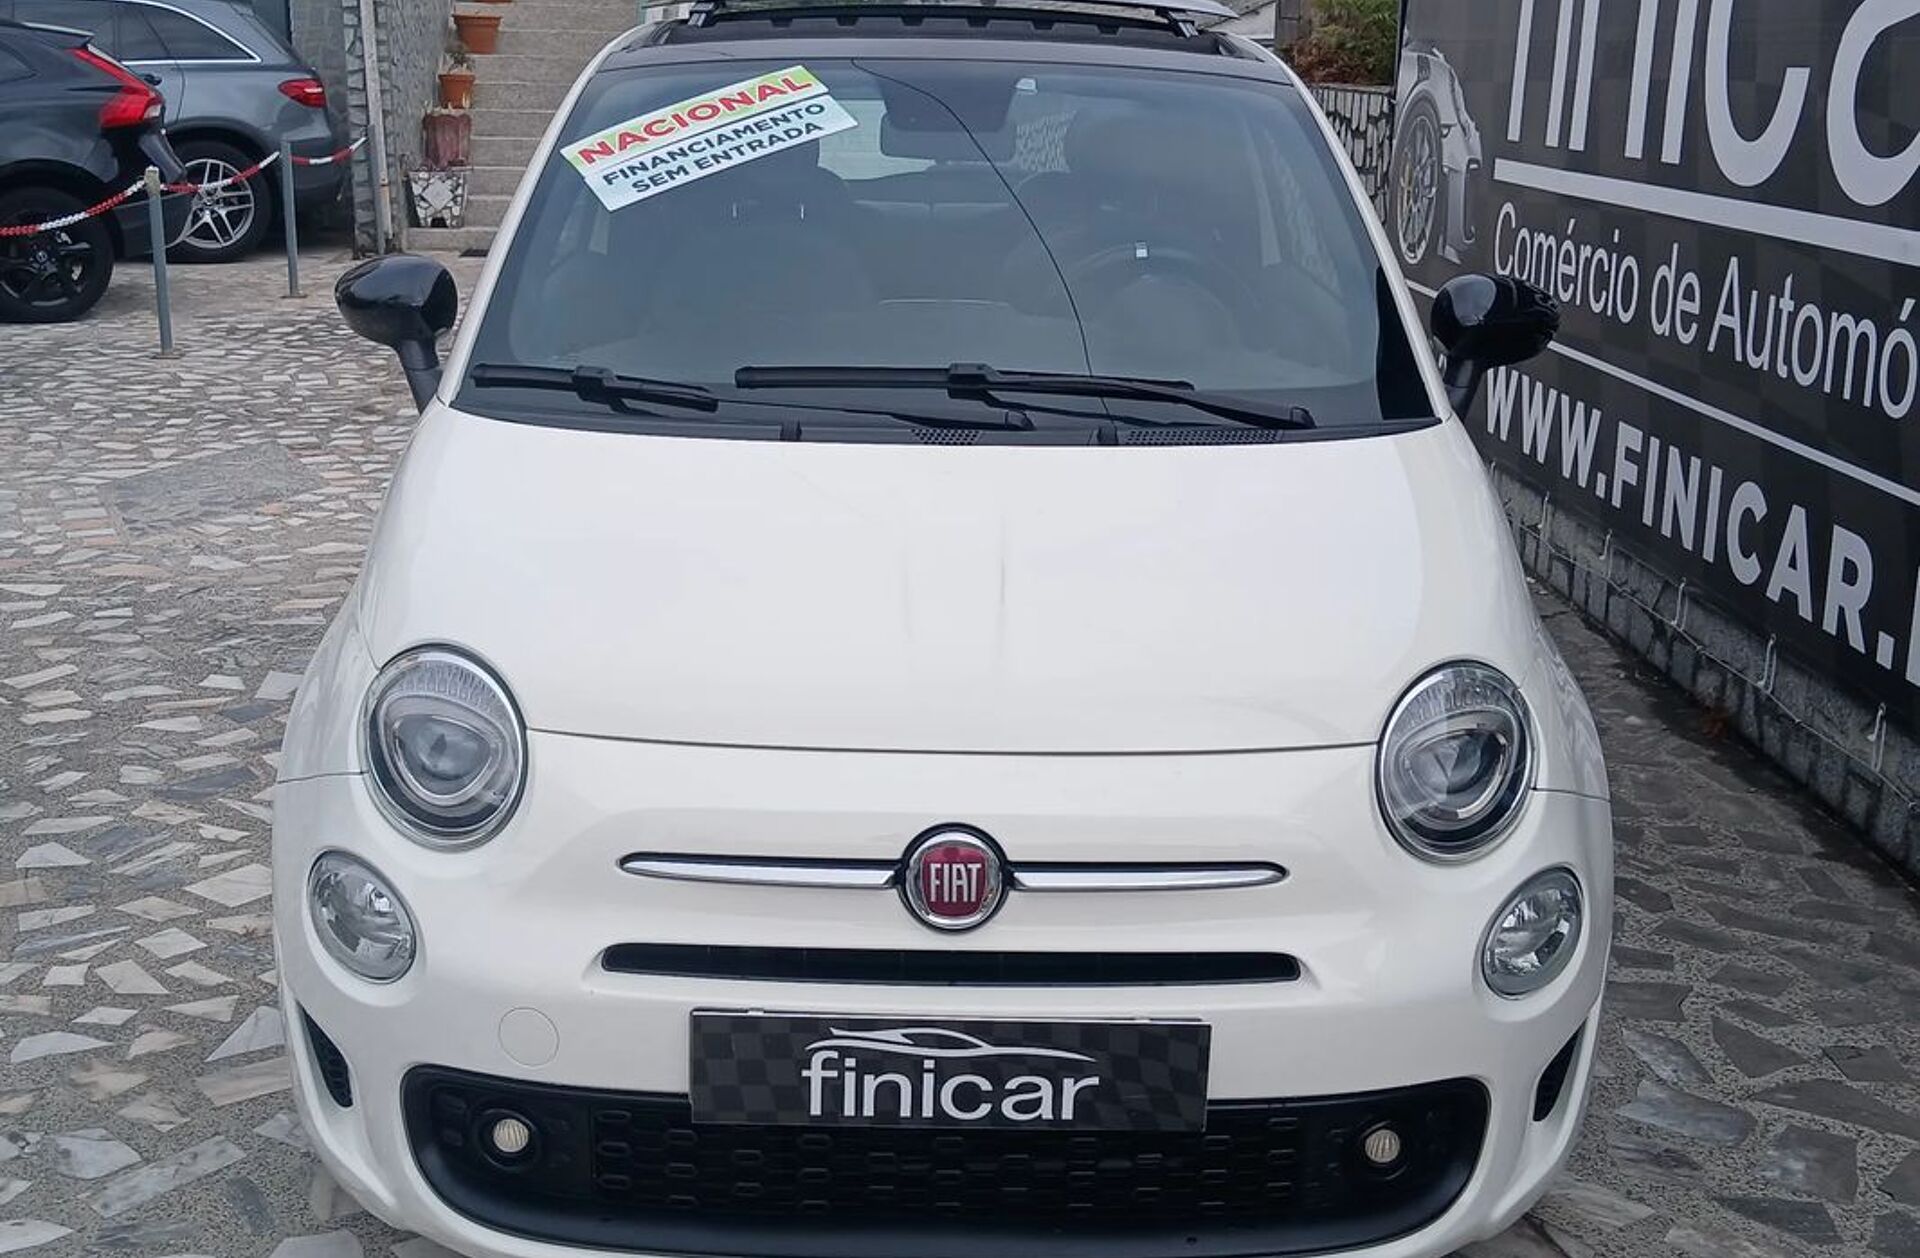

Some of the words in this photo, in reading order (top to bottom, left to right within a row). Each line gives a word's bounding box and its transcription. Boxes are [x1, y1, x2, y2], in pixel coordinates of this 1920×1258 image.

[577, 75, 813, 165] NACIONAL
[602, 103, 826, 186] FINANCIAMENTO
[631, 164, 690, 194] SEM
[693, 122, 824, 172] ENTRADA
[1494, 201, 1639, 325] Comércio
[1650, 242, 1701, 345] de
[1486, 365, 1920, 689] WWW.FINICAR.
[929, 862, 982, 903] FIAT
[801, 1050, 1100, 1121] finicar
